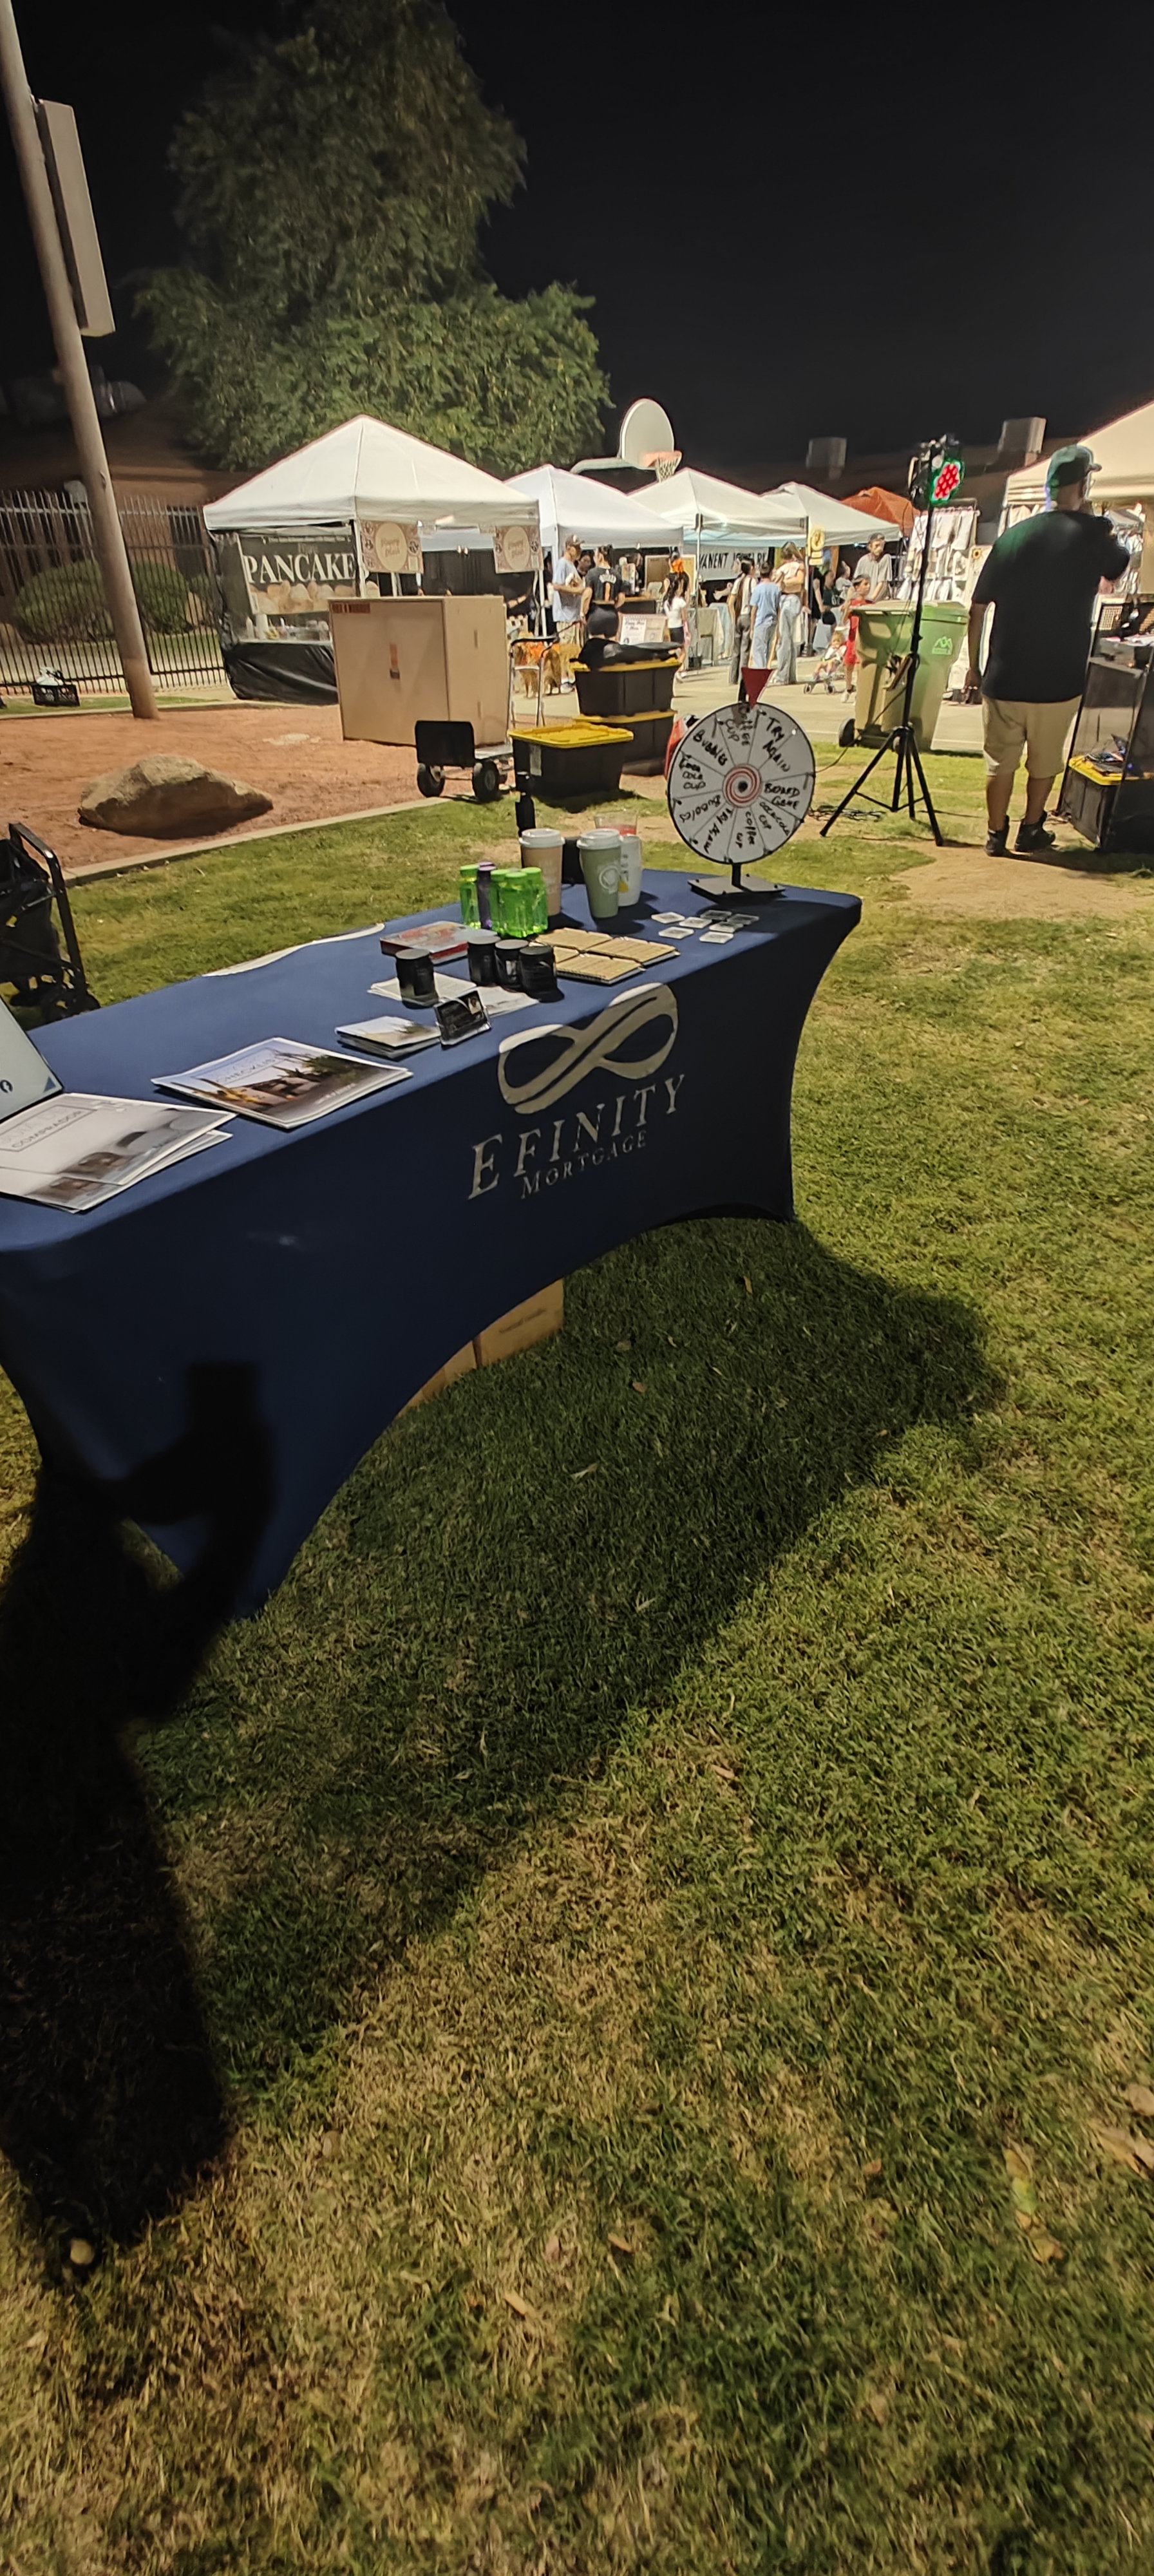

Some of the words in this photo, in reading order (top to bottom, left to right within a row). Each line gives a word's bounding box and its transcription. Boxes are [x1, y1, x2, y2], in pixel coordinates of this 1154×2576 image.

[243, 553, 369, 583] PANCAKE
[766, 716, 784, 743] TRY
[762, 740, 791, 773] AGAIN
[467, 1074, 685, 1200] EFINITY
[521, 1130, 647, 1199] MORTGAGE
